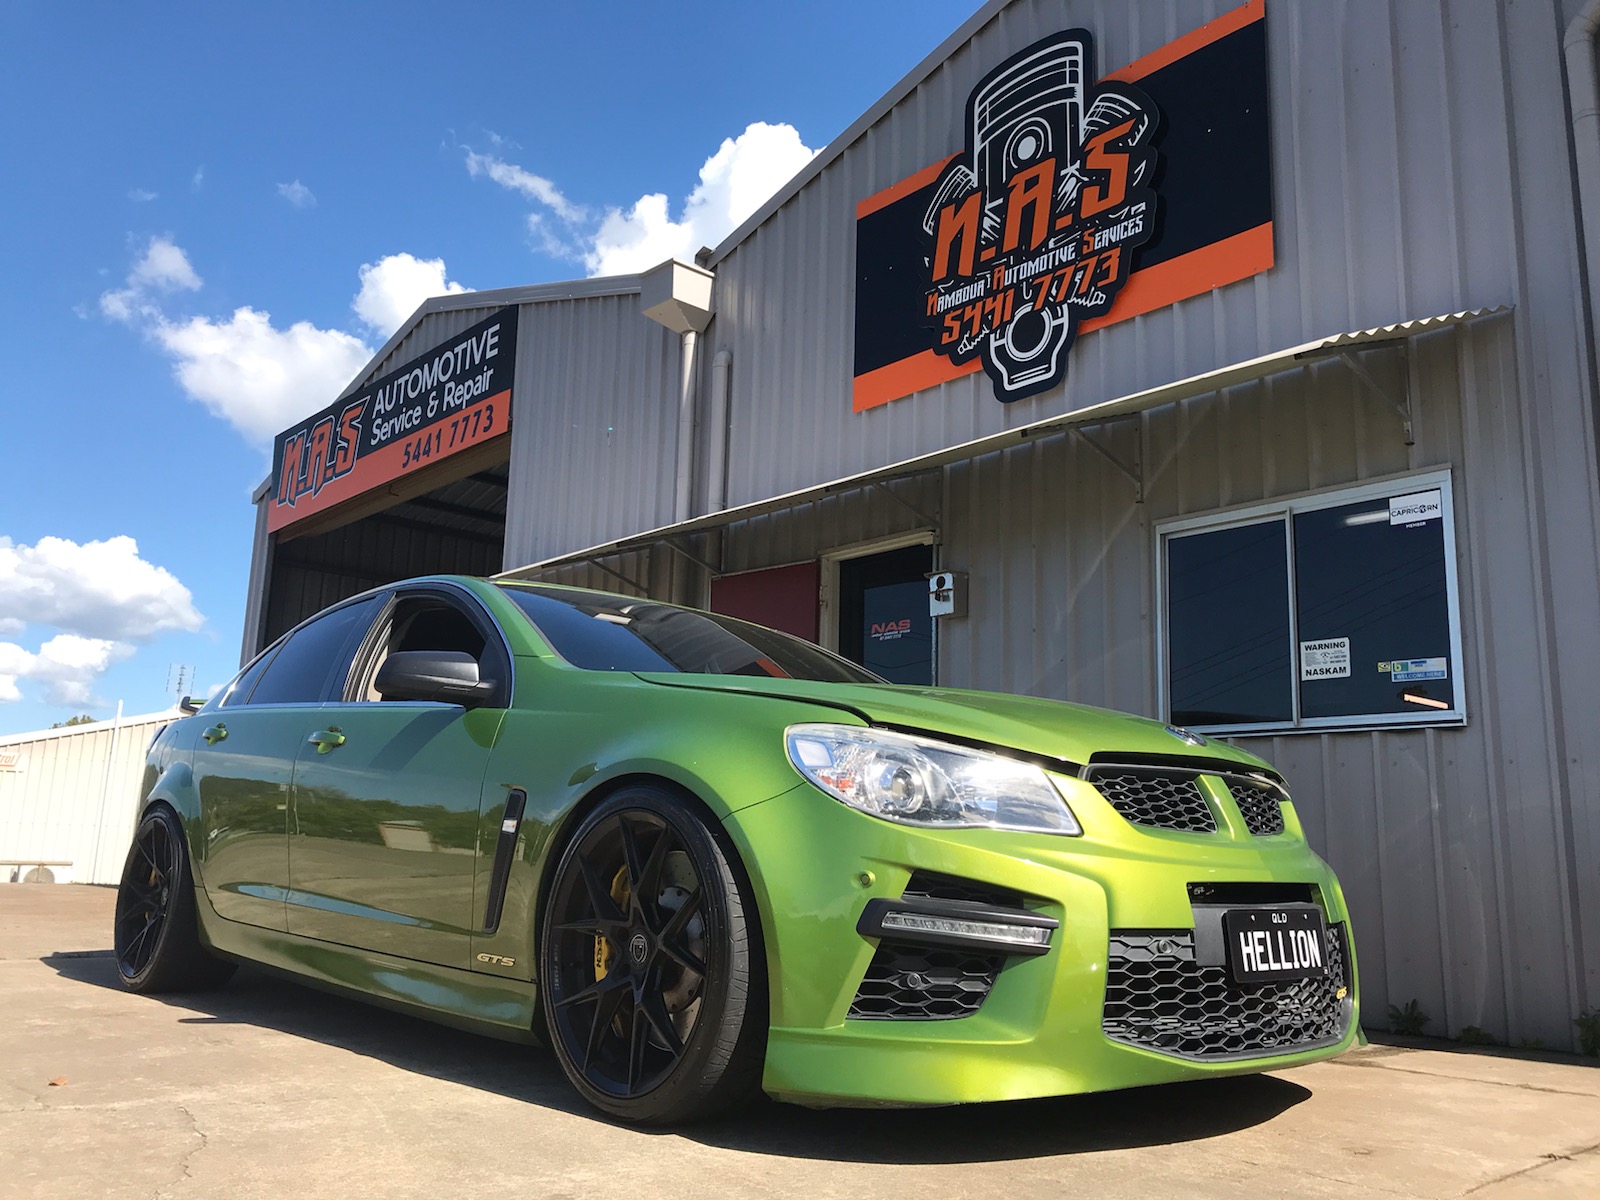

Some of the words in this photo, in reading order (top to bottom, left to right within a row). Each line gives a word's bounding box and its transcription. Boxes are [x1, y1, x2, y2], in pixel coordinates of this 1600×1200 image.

[993, 242, 1077, 290] AUTOMOTIVE
[1083, 214, 1143, 252] SERVICES
[941, 289, 1015, 345] 5441
[1032, 247, 1122, 312] 7773
[372, 323, 501, 419] AUTOMOTIVE
[370, 406, 422, 446] Service
[426, 391, 439, 419] &
[442, 365, 494, 410] Repair
[402, 428, 442, 469] 5441
[449, 404, 494, 449] 7773
[871, 619, 911, 634] NAS
[1304, 641, 1346, 652] WARNING
[1305, 666, 1347, 677] NASKAM
[1271, 912, 1288, 924] QLD
[476, 952, 516, 968] GTS
[1239, 929, 1322, 972] HELLION
